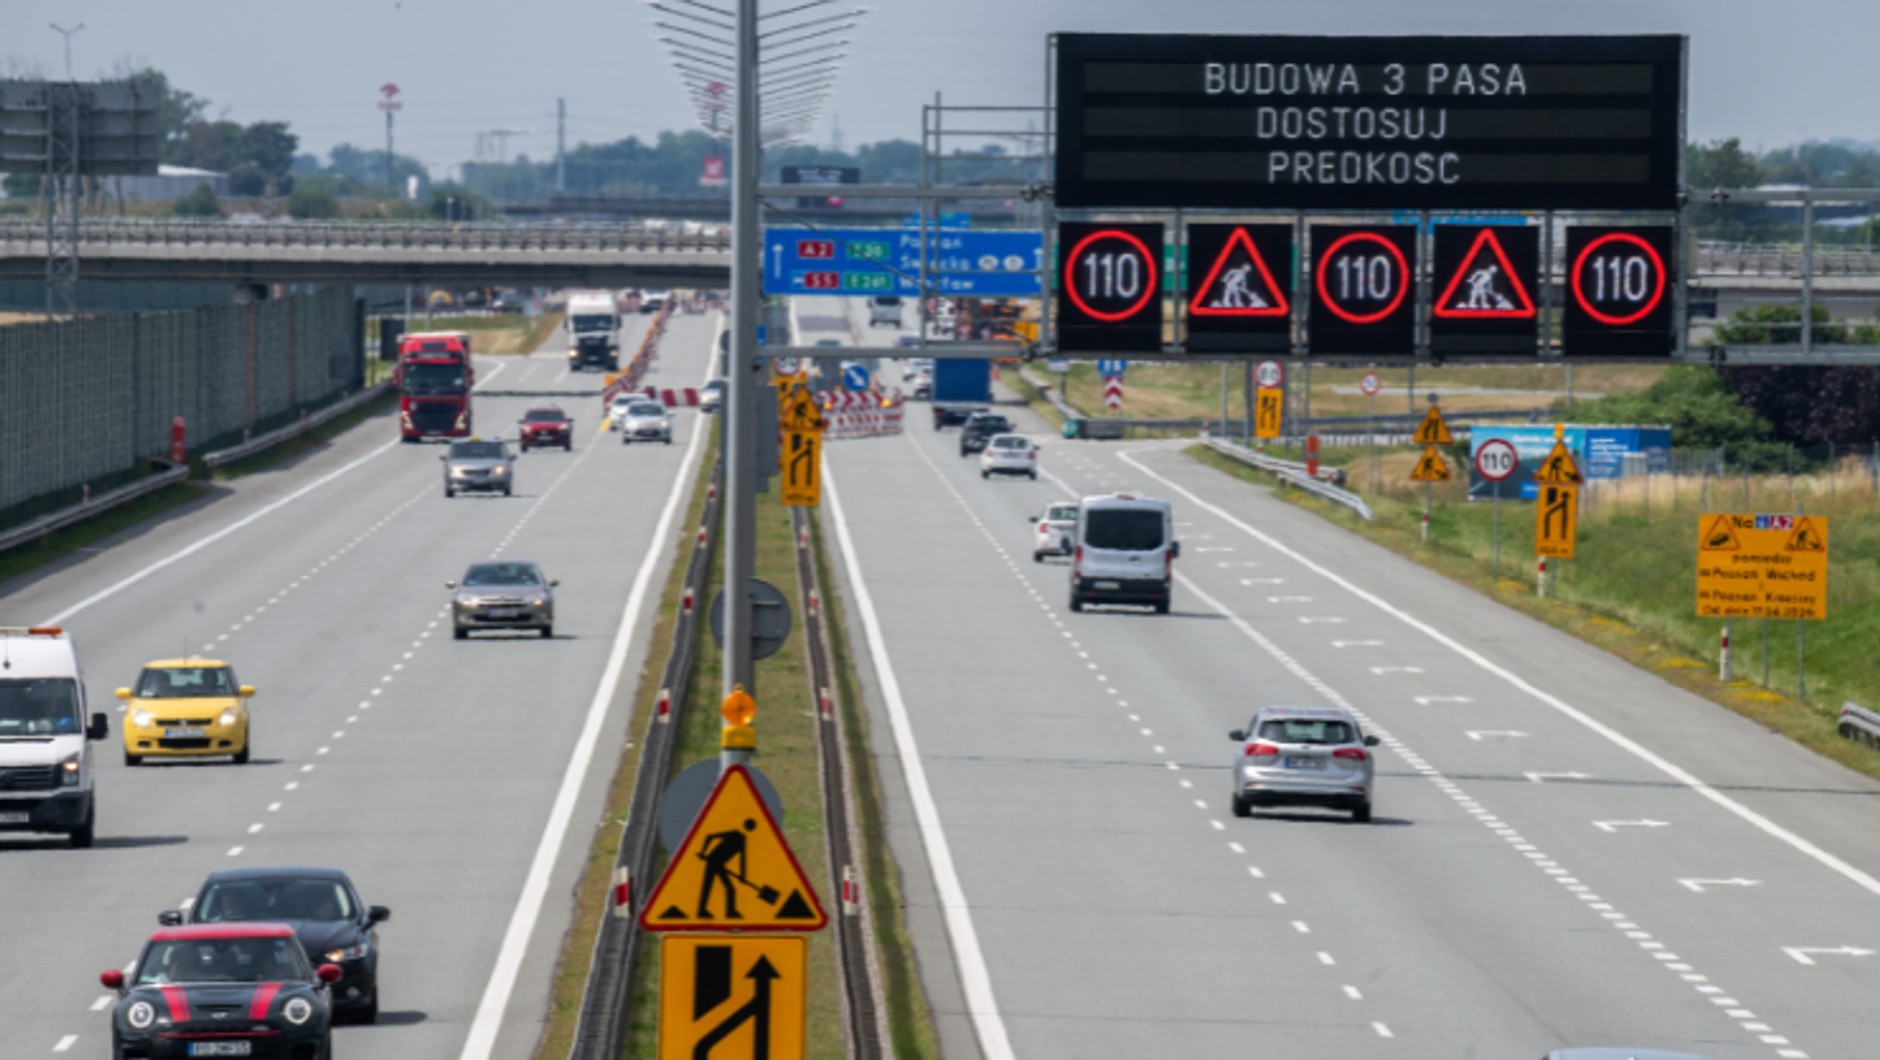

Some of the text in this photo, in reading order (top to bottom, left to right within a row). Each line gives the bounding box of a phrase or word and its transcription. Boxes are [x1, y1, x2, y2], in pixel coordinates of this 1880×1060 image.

[1205, 63, 1527, 95] BUDOWA 3 PASA
[1257, 107, 1447, 140] DOSTOSUJ
[1085, 253, 1138, 298] 110
[1338, 255, 1391, 300] 110
[1593, 257, 1648, 301] 110
[1483, 451, 1512, 470] 110
